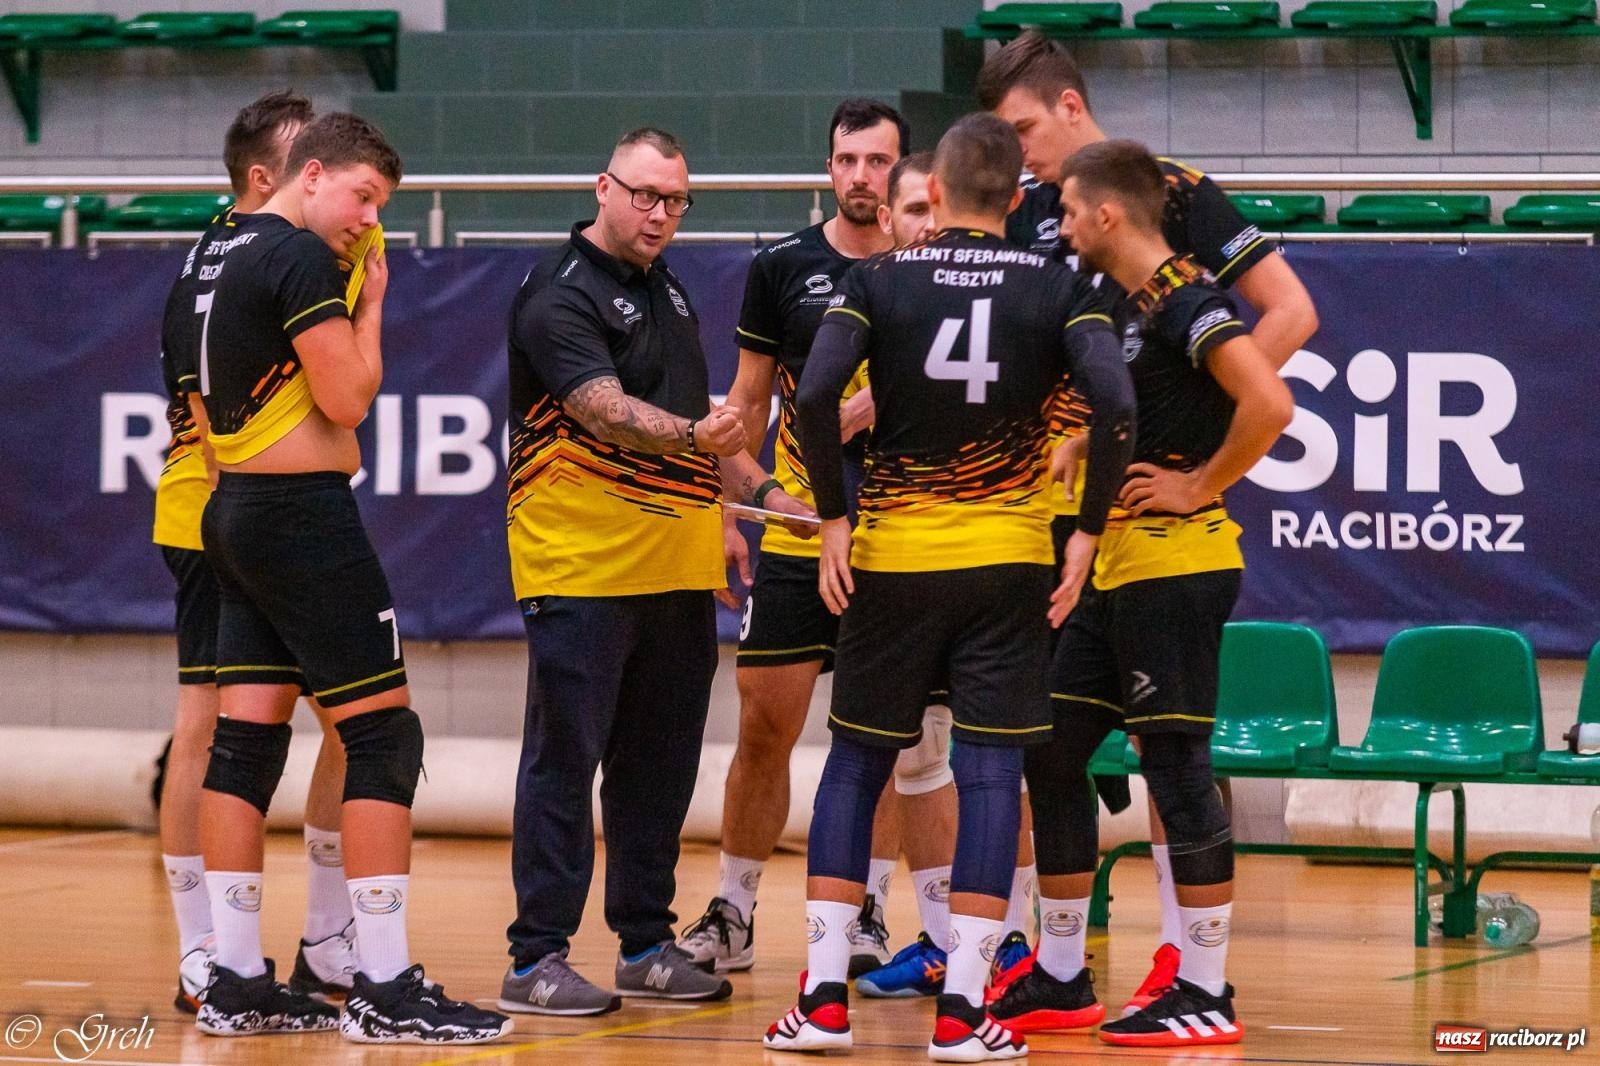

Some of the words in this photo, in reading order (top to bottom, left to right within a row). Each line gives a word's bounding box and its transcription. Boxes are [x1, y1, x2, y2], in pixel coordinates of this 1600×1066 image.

[768, 238, 801, 254] DAMONS
[894, 247, 952, 263] TALENT
[953, 248, 1047, 268] SFERAWENT
[932, 268, 1005, 288] CIESZYN
[194, 289, 216, 397] 7
[923, 297, 1000, 404] 4
[1271, 500, 1525, 552] RACIBÓRZ
[378, 607, 401, 661] 7
[644, 962, 674, 990] N
[528, 979, 559, 1007] N
